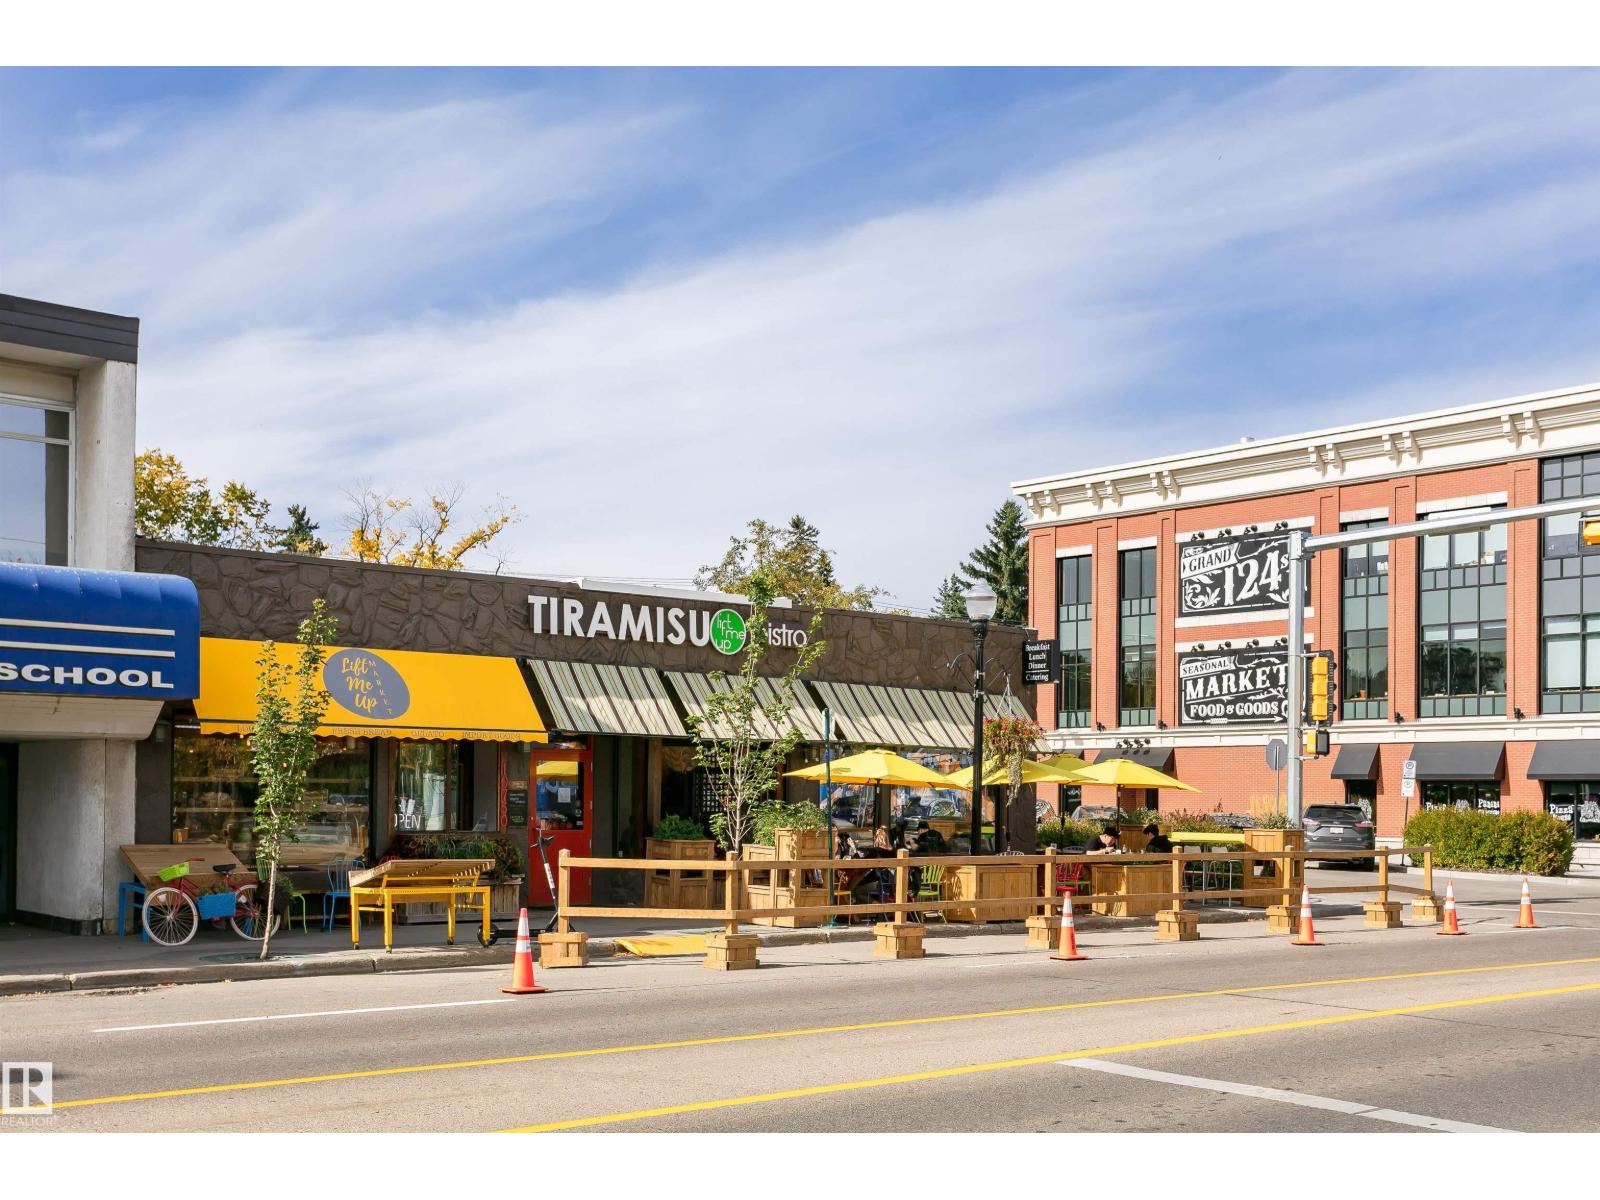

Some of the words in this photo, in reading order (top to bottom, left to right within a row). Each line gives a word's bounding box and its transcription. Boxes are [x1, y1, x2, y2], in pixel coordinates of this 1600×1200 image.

[1189, 548, 1232, 573] GRAND
[1224, 550, 1282, 606] 124
[528, 594, 710, 647] TIRAMISU
[726, 630, 745, 640] me
[762, 622, 807, 647] istro
[715, 639, 732, 653] up
[1025, 643, 1050, 651] Breakfast
[1028, 652, 1046, 660] Lunch
[341, 657, 369, 676] Lift
[1182, 659, 1230, 676] SEASONAL
[0, 662, 174, 689] SCHOOL
[1025, 673, 1049, 681] Catering
[1186, 664, 1289, 701] MARKET
[346, 676, 374, 694] Me
[354, 694, 378, 713] Up
[1190, 703, 1225, 717] FOOD
[1235, 702, 1279, 715] GOODS
[332, 728, 361, 736] FRESH
[411, 730, 445, 738] GELATO
[1549, 803, 1574, 815] Pizza
